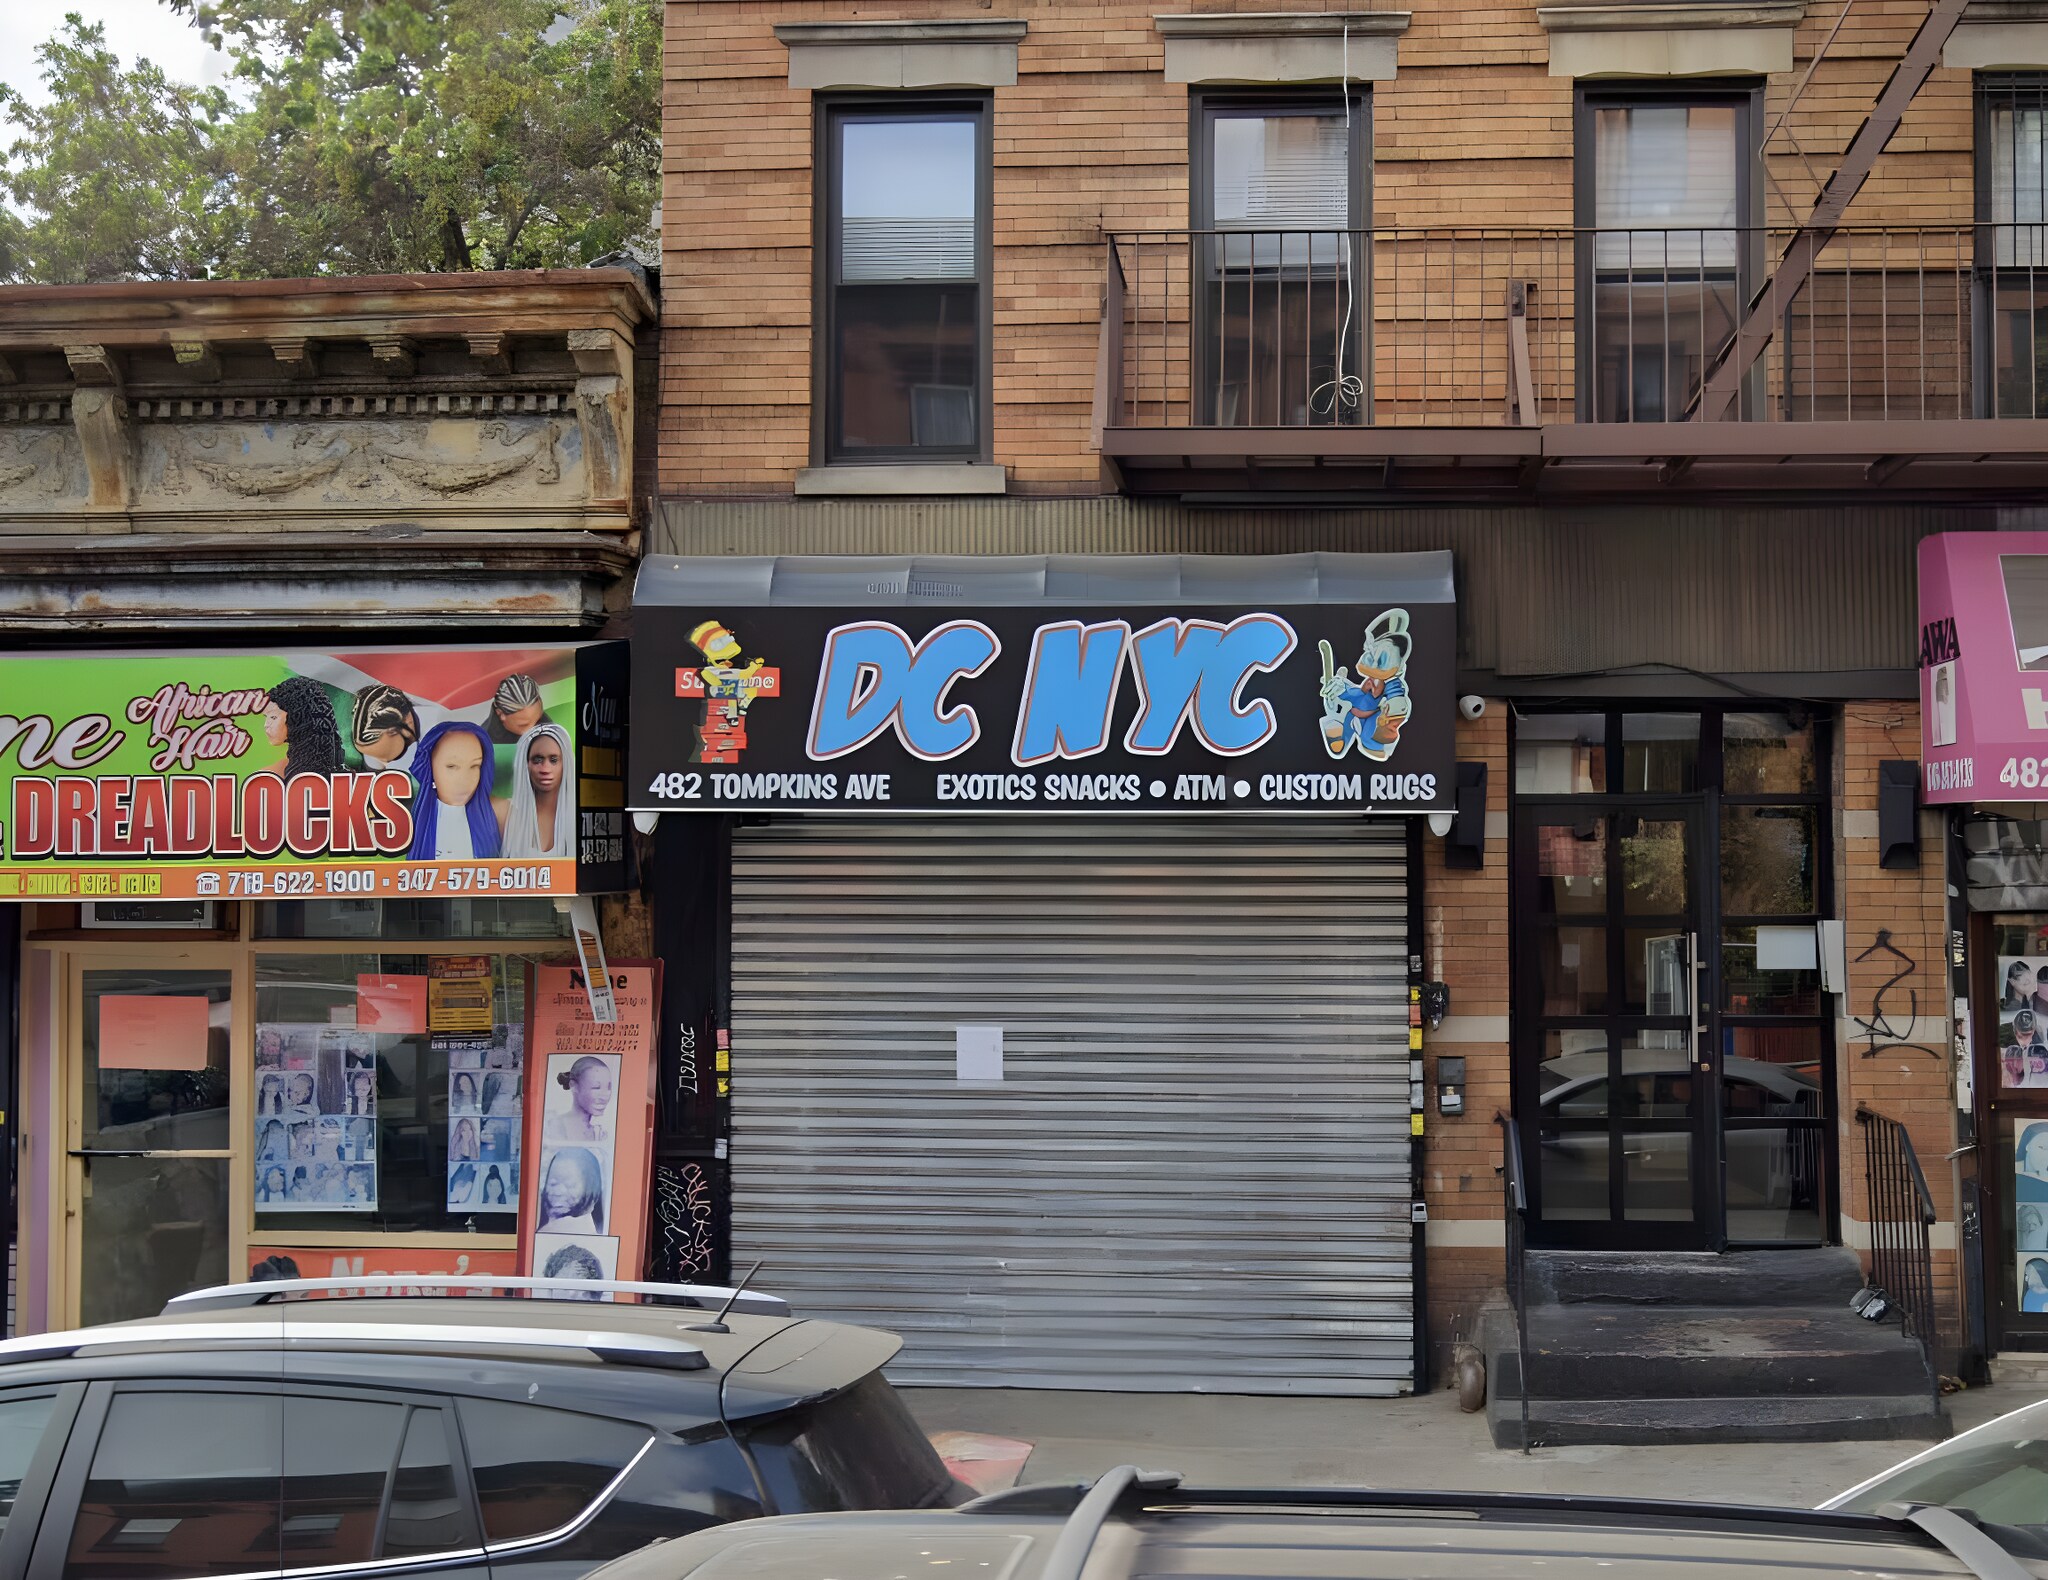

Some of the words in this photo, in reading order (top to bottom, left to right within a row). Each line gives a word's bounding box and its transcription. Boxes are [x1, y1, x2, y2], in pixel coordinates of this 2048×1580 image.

[126, 682, 271, 747] African
[805, 619, 1001, 762] DC
[1010, 613, 1298, 768] NYC
[150, 717, 253, 773] Hair
[11, 771, 414, 861] DREADLOCKS
[648, 772, 702, 799] 482
[710, 773, 838, 800] TOMPKINS
[844, 774, 891, 800] AVE
[937, 774, 1037, 800] EXOTICS
[1044, 774, 1141, 801] SNACKS
[1173, 774, 1226, 801] ATM
[1259, 773, 1362, 801] CUSTOM
[1370, 773, 1437, 801] RUGS
